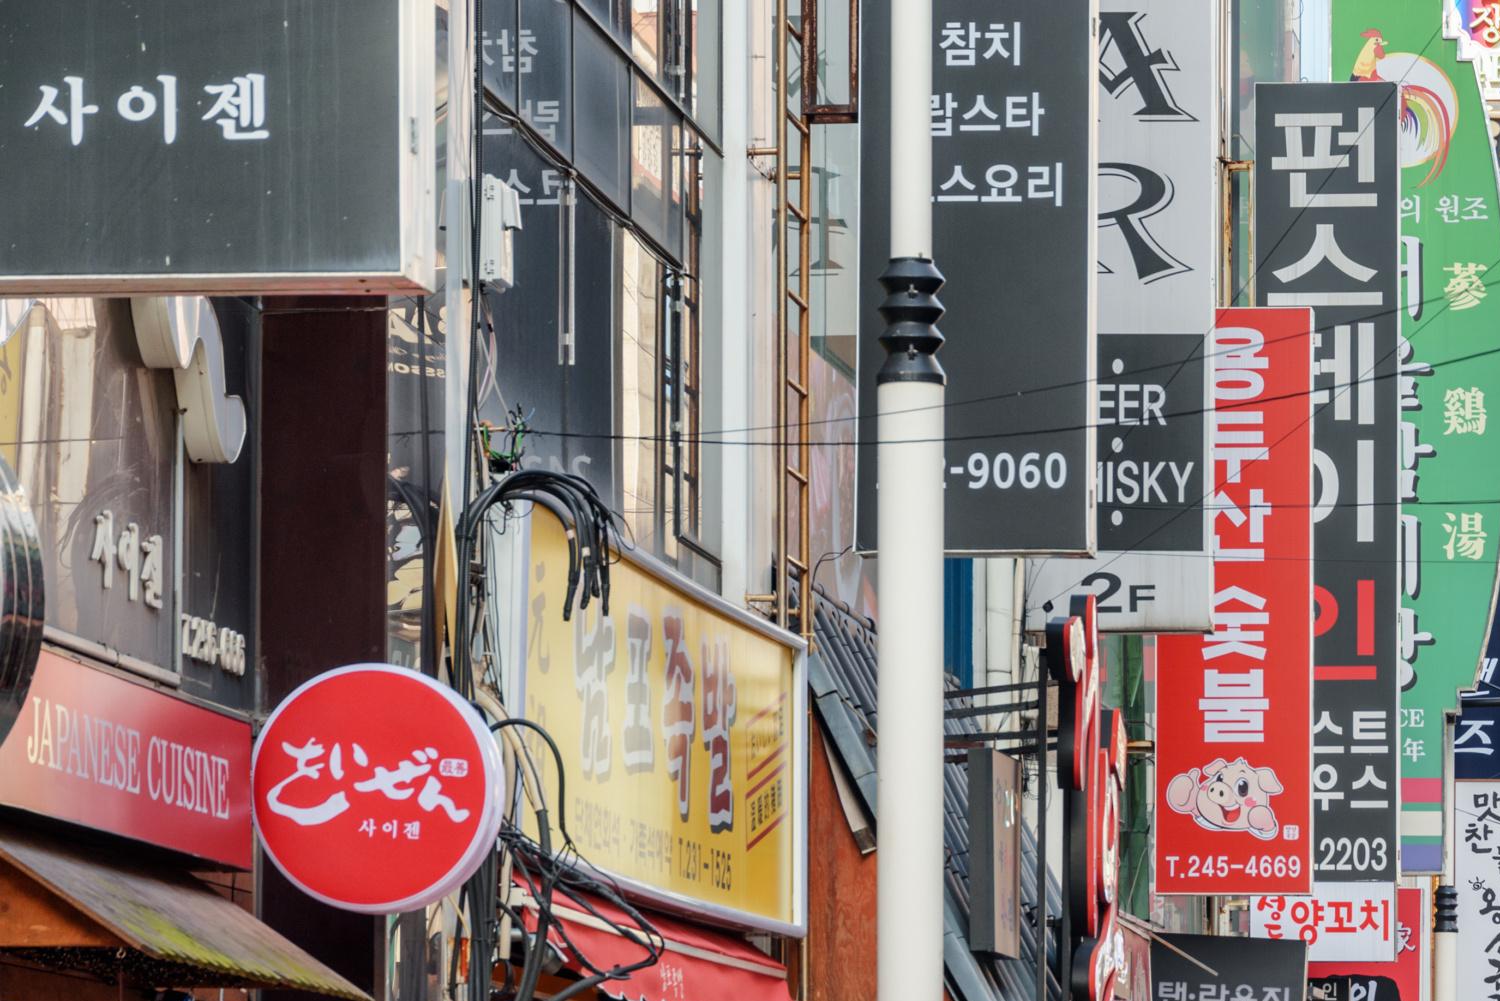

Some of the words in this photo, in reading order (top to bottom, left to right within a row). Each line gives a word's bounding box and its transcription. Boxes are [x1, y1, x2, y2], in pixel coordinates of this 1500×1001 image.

[939, 21, 1022, 67] 참치
[24, 72, 270, 146] 사이젠
[930, 161, 1064, 208] 스요리
[1435, 193, 1490, 225] 원조
[943, 451, 1068, 491] -9060
[91, 509, 165, 610] 사이젠
[1081, 571, 1156, 614] 2F
[1199, 584, 1272, 745] 숯불
[27, 696, 140, 796] JAPANESE
[146, 734, 231, 821] CUISINE
[265, 735, 471, 827] さいぜん
[357, 818, 422, 842] 사이젠
[1165, 854, 1302, 879] T.245-4669
[1290, 898, 1390, 947] 양꼬치
